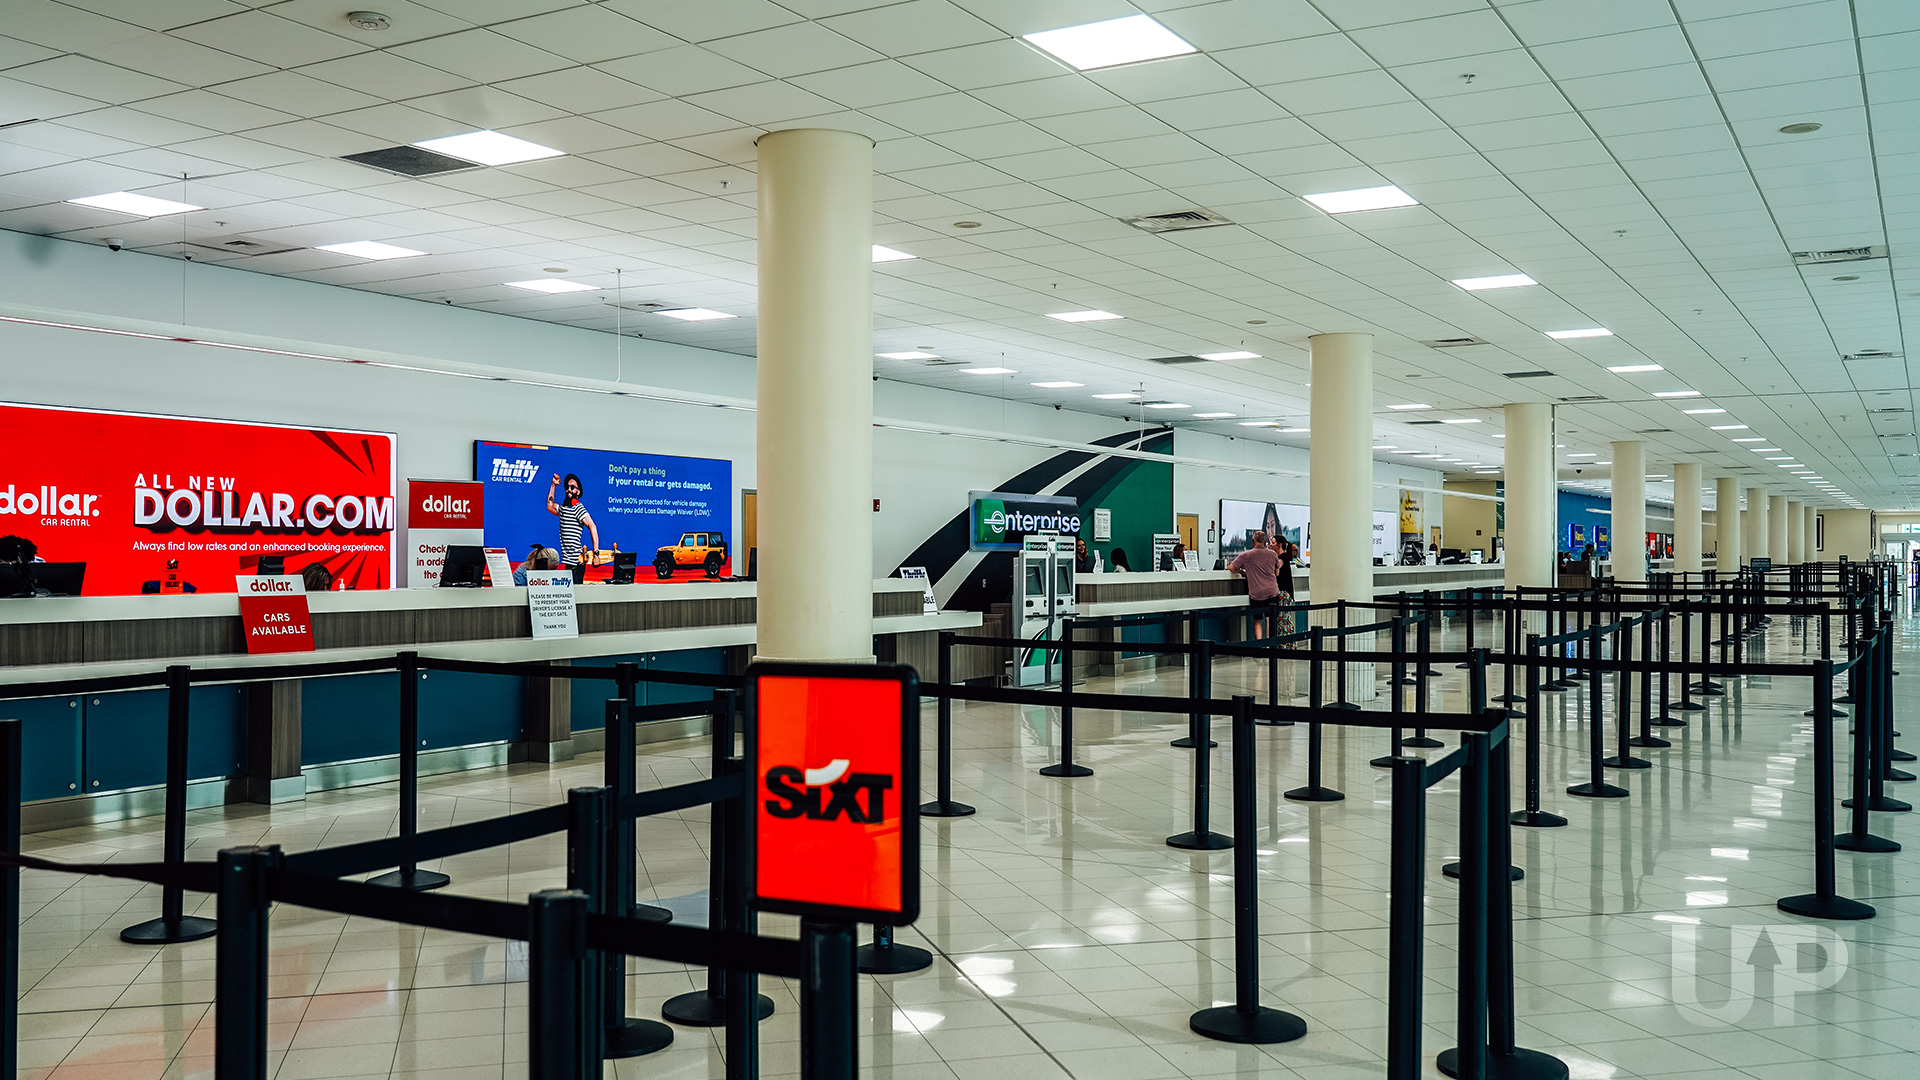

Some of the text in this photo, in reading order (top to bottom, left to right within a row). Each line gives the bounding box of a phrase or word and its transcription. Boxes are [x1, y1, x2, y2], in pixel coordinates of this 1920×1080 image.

[492, 458, 539, 483] Thrifty
[609, 464, 627, 473] Don't
[629, 467, 641, 475] pay
[649, 467, 665, 477] thing
[134, 473, 235, 490] ALL NEW
[609, 476, 614, 484] if
[616, 478, 631, 486] your
[668, 480, 681, 490] gets
[683, 481, 712, 491] damaged.
[0, 484, 100, 517] dollar.
[422, 495, 471, 513] dollar.
[134, 487, 394, 531] DOLLAR.COM
[657, 508, 676, 516] Damage
[984, 510, 1080, 534] enterprise
[133, 541, 165, 552] Always
[168, 542, 185, 550] find
[188, 542, 203, 550] low
[206, 542, 227, 550] rates
[229, 542, 247, 550] and
[263, 542, 306, 551] enhanced
[308, 543, 340, 553] booking
[342, 543, 385, 552] experience.
[419, 544, 446, 553] Check
[416, 558, 444, 566] in orde
[424, 570, 437, 579] the
[250, 579, 293, 592] dollar.
[552, 578, 571, 587] Thrifty
[264, 613, 290, 622] CARS
[252, 625, 307, 636] AVAILABLE
